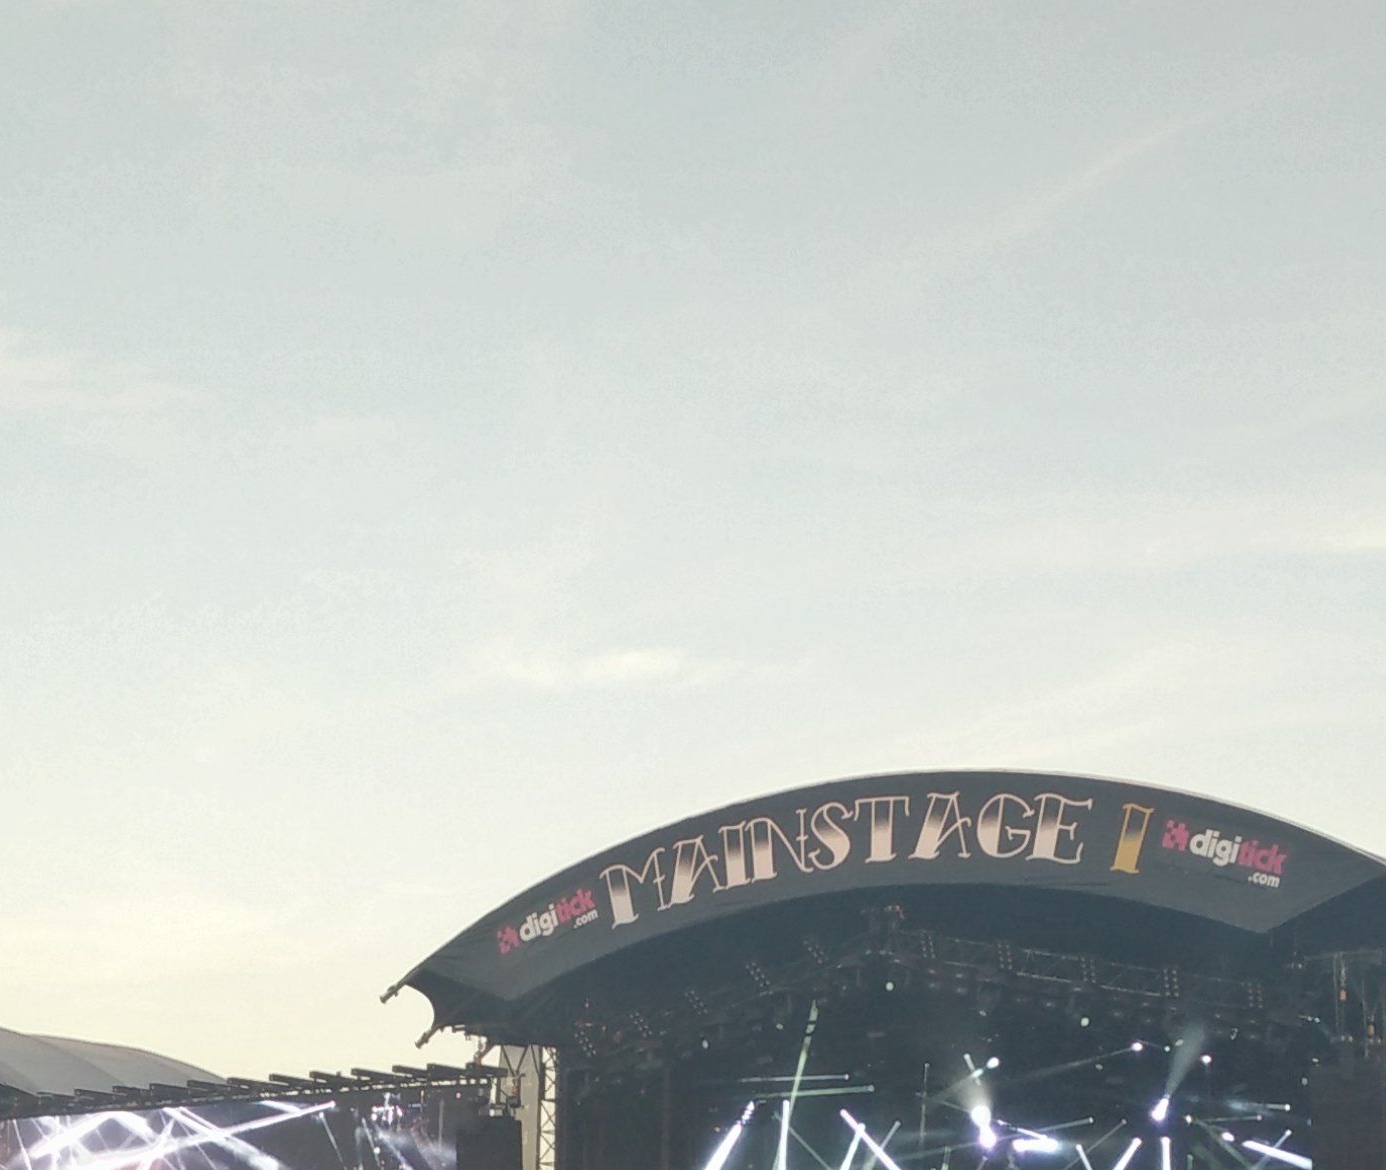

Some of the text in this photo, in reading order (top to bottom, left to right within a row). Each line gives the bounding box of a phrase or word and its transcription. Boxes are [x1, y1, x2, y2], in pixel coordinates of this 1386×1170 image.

[599, 791, 1093, 929] MAINSTAGE
[1189, 828, 1288, 876] digitick
[1247, 871, 1281, 888] .com
[519, 888, 597, 942] digitick
[573, 909, 599, 929] .com
